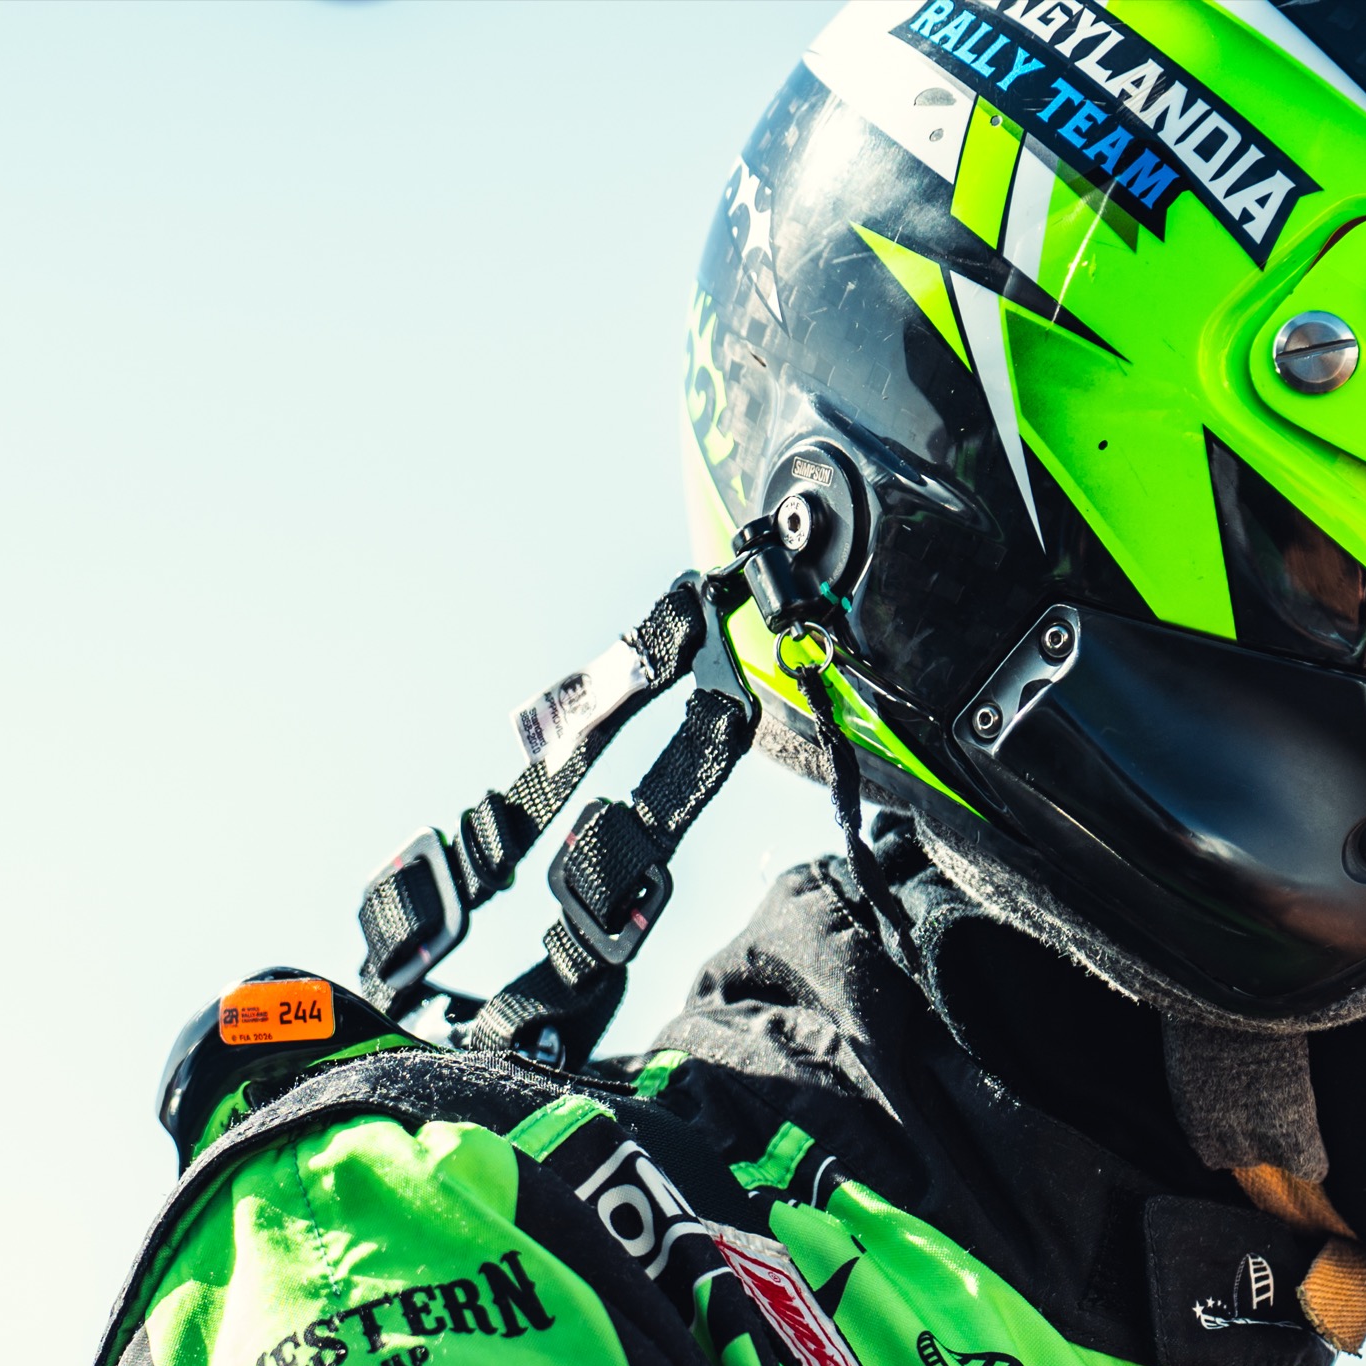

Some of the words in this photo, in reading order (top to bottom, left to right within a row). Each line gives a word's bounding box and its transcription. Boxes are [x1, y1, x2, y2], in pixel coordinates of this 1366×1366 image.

[909, 0, 1046, 92] RALLY
[1035, 77, 1181, 210] TEAM
[1002, 0, 1297, 246] GYLANDIA
[794, 459, 832, 486] SIMPSON
[279, 999, 323, 1026] 244
[239, 1033, 252, 1042] FIA
[254, 1032, 274, 1041] 2026
